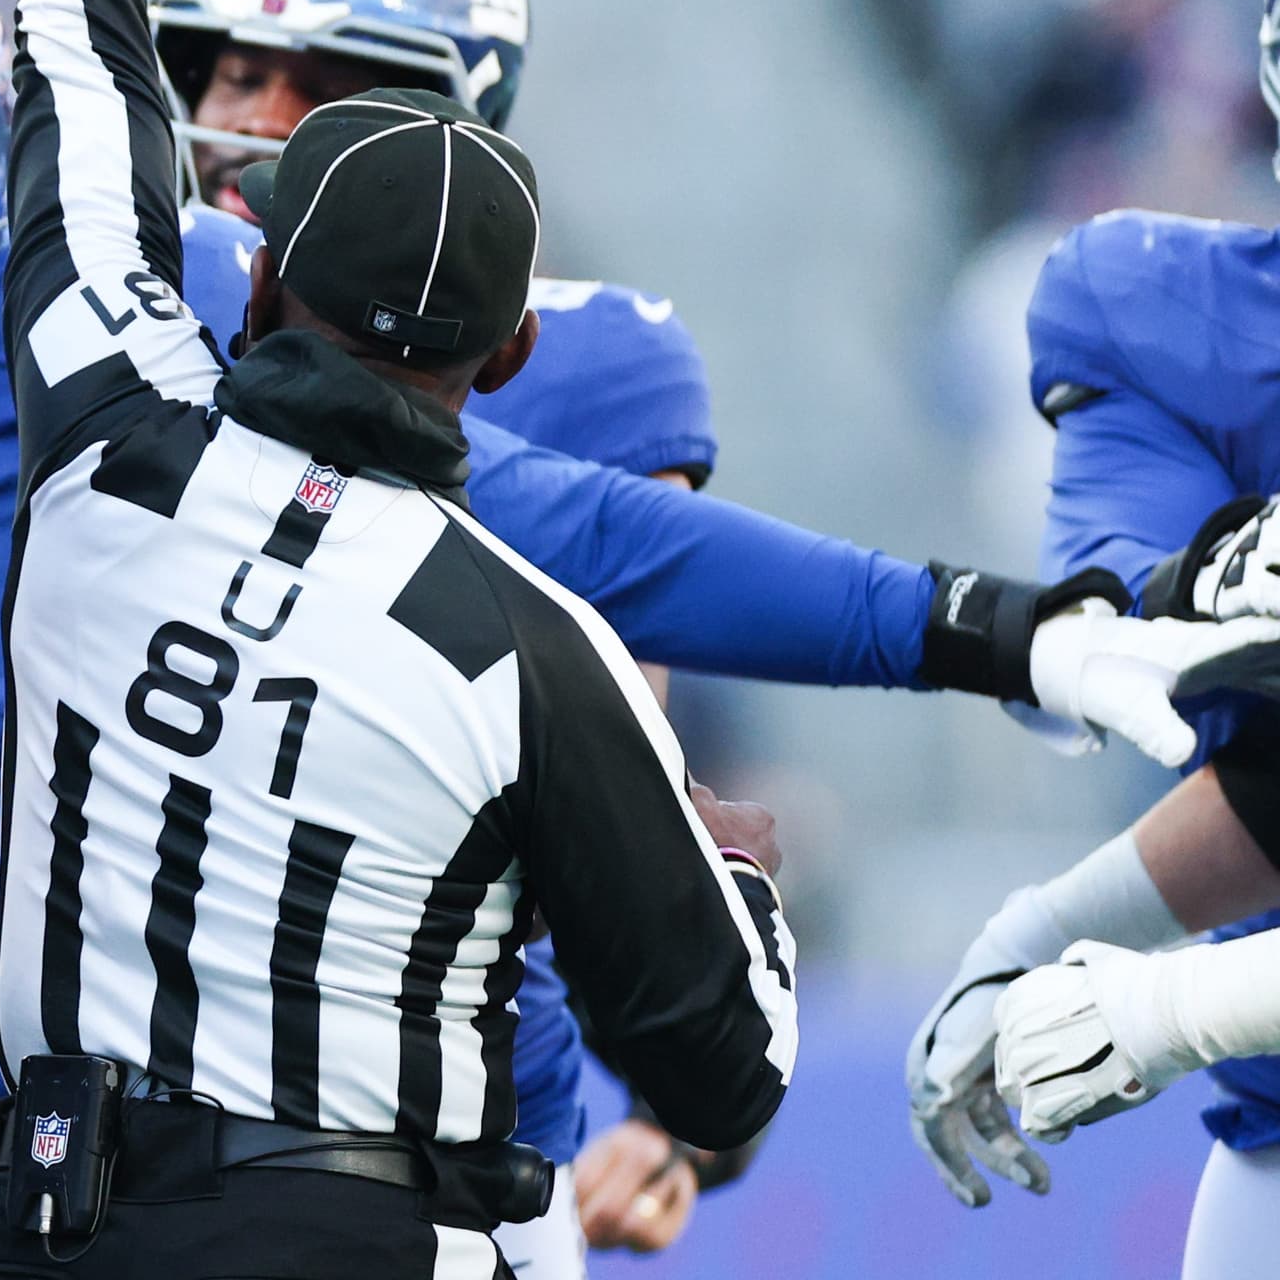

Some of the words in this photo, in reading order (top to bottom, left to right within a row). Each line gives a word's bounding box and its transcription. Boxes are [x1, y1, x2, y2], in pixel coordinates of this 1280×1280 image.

[299, 478, 333, 507] NFL
[220, 560, 303, 642] U
[125, 620, 318, 800] 81
[36, 1135, 62, 1158] NFL
